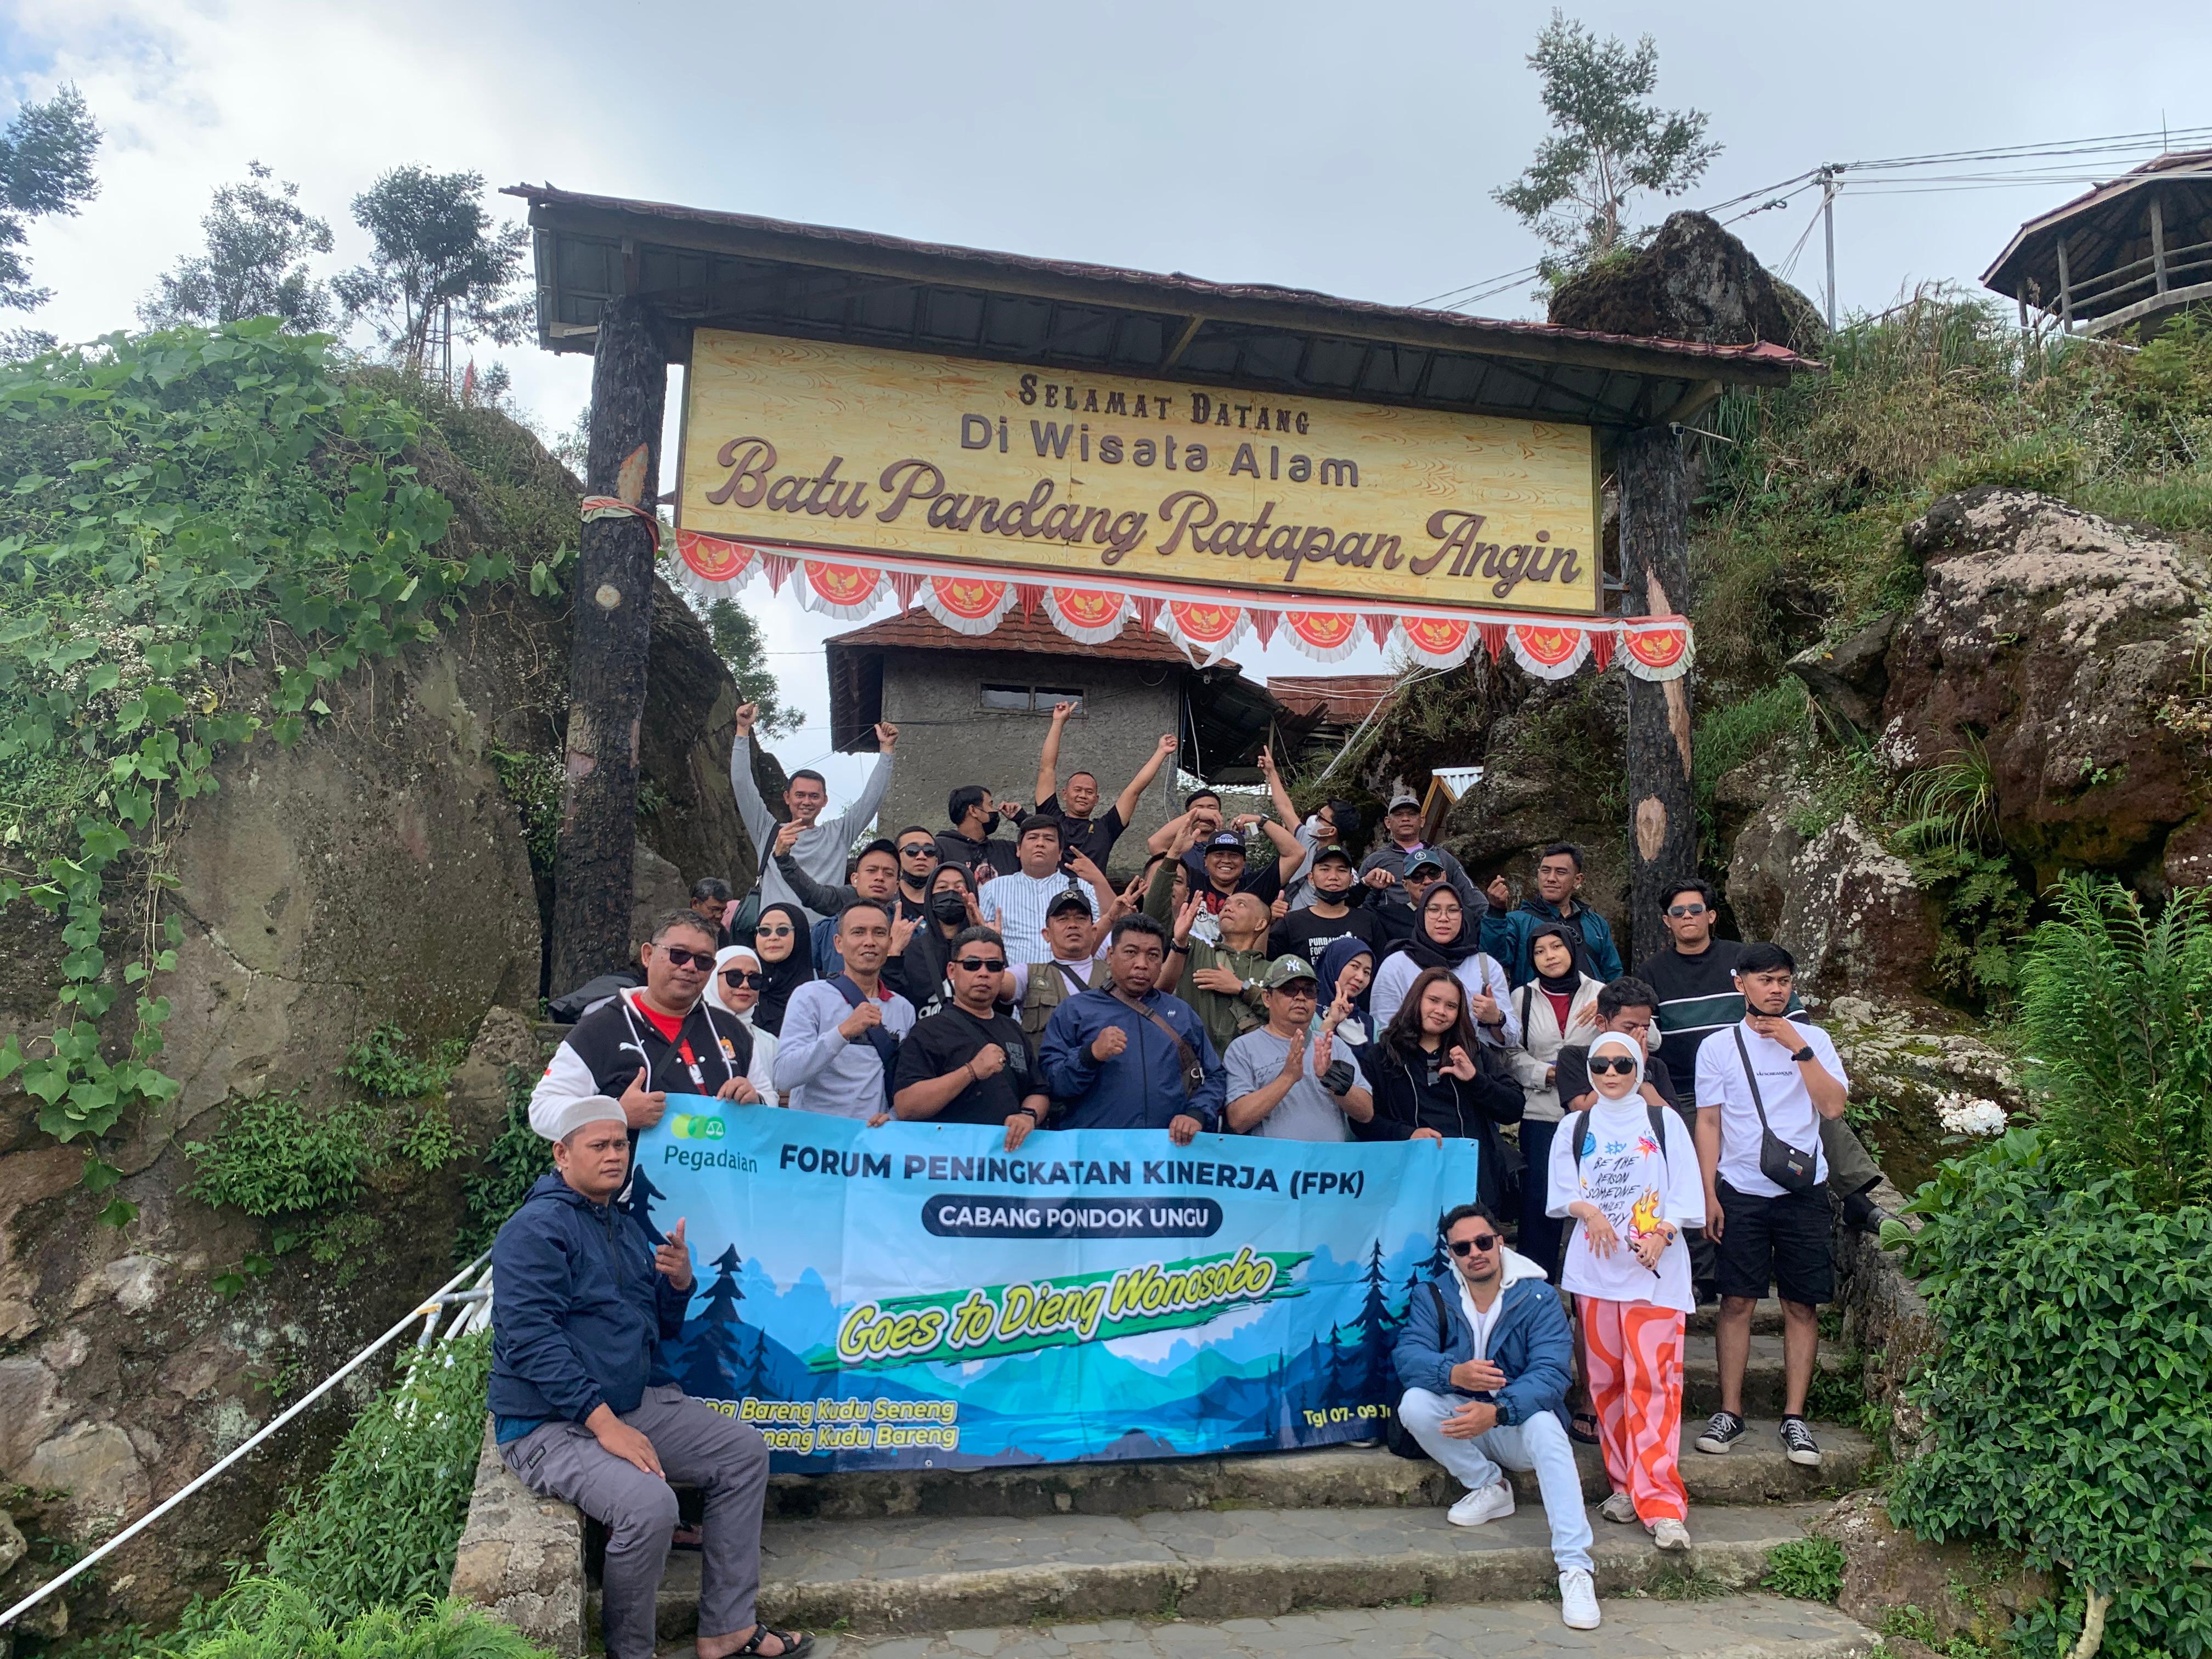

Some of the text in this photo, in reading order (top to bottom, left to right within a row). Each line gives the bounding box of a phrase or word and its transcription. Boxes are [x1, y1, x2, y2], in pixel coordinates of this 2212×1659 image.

[960, 413, 1359, 488] Di Wisata Alam
[706, 436, 1582, 599] Batu Pandang Ratapan Angin
[664, 1145, 758, 1174] Pegadaian
[780, 1144, 1364, 1199] FORUM PENINGKATAN KINERJA (FPK)
[1593, 1156, 1640, 1171] BE THE
[1595, 1172, 1630, 1187] REASON
[1586, 1185, 1640, 1200] SOMEONE
[938, 1205, 1210, 1228] CABANG PONDOK UNGU
[838, 1246, 1273, 1359] Goes to Dieng Wonosobo
[740, 1400, 814, 1425] Bareng
[817, 1400, 869, 1420] Kudu
[872, 1400, 956, 1423] Seneng
[1302, 1408, 1328, 1429] Tgl
[1330, 1407, 1355, 1423] 07-
[1357, 1404, 1378, 1419] 09
[817, 1426, 870, 1447] Kudu
[876, 1426, 958, 1449] Bareng
